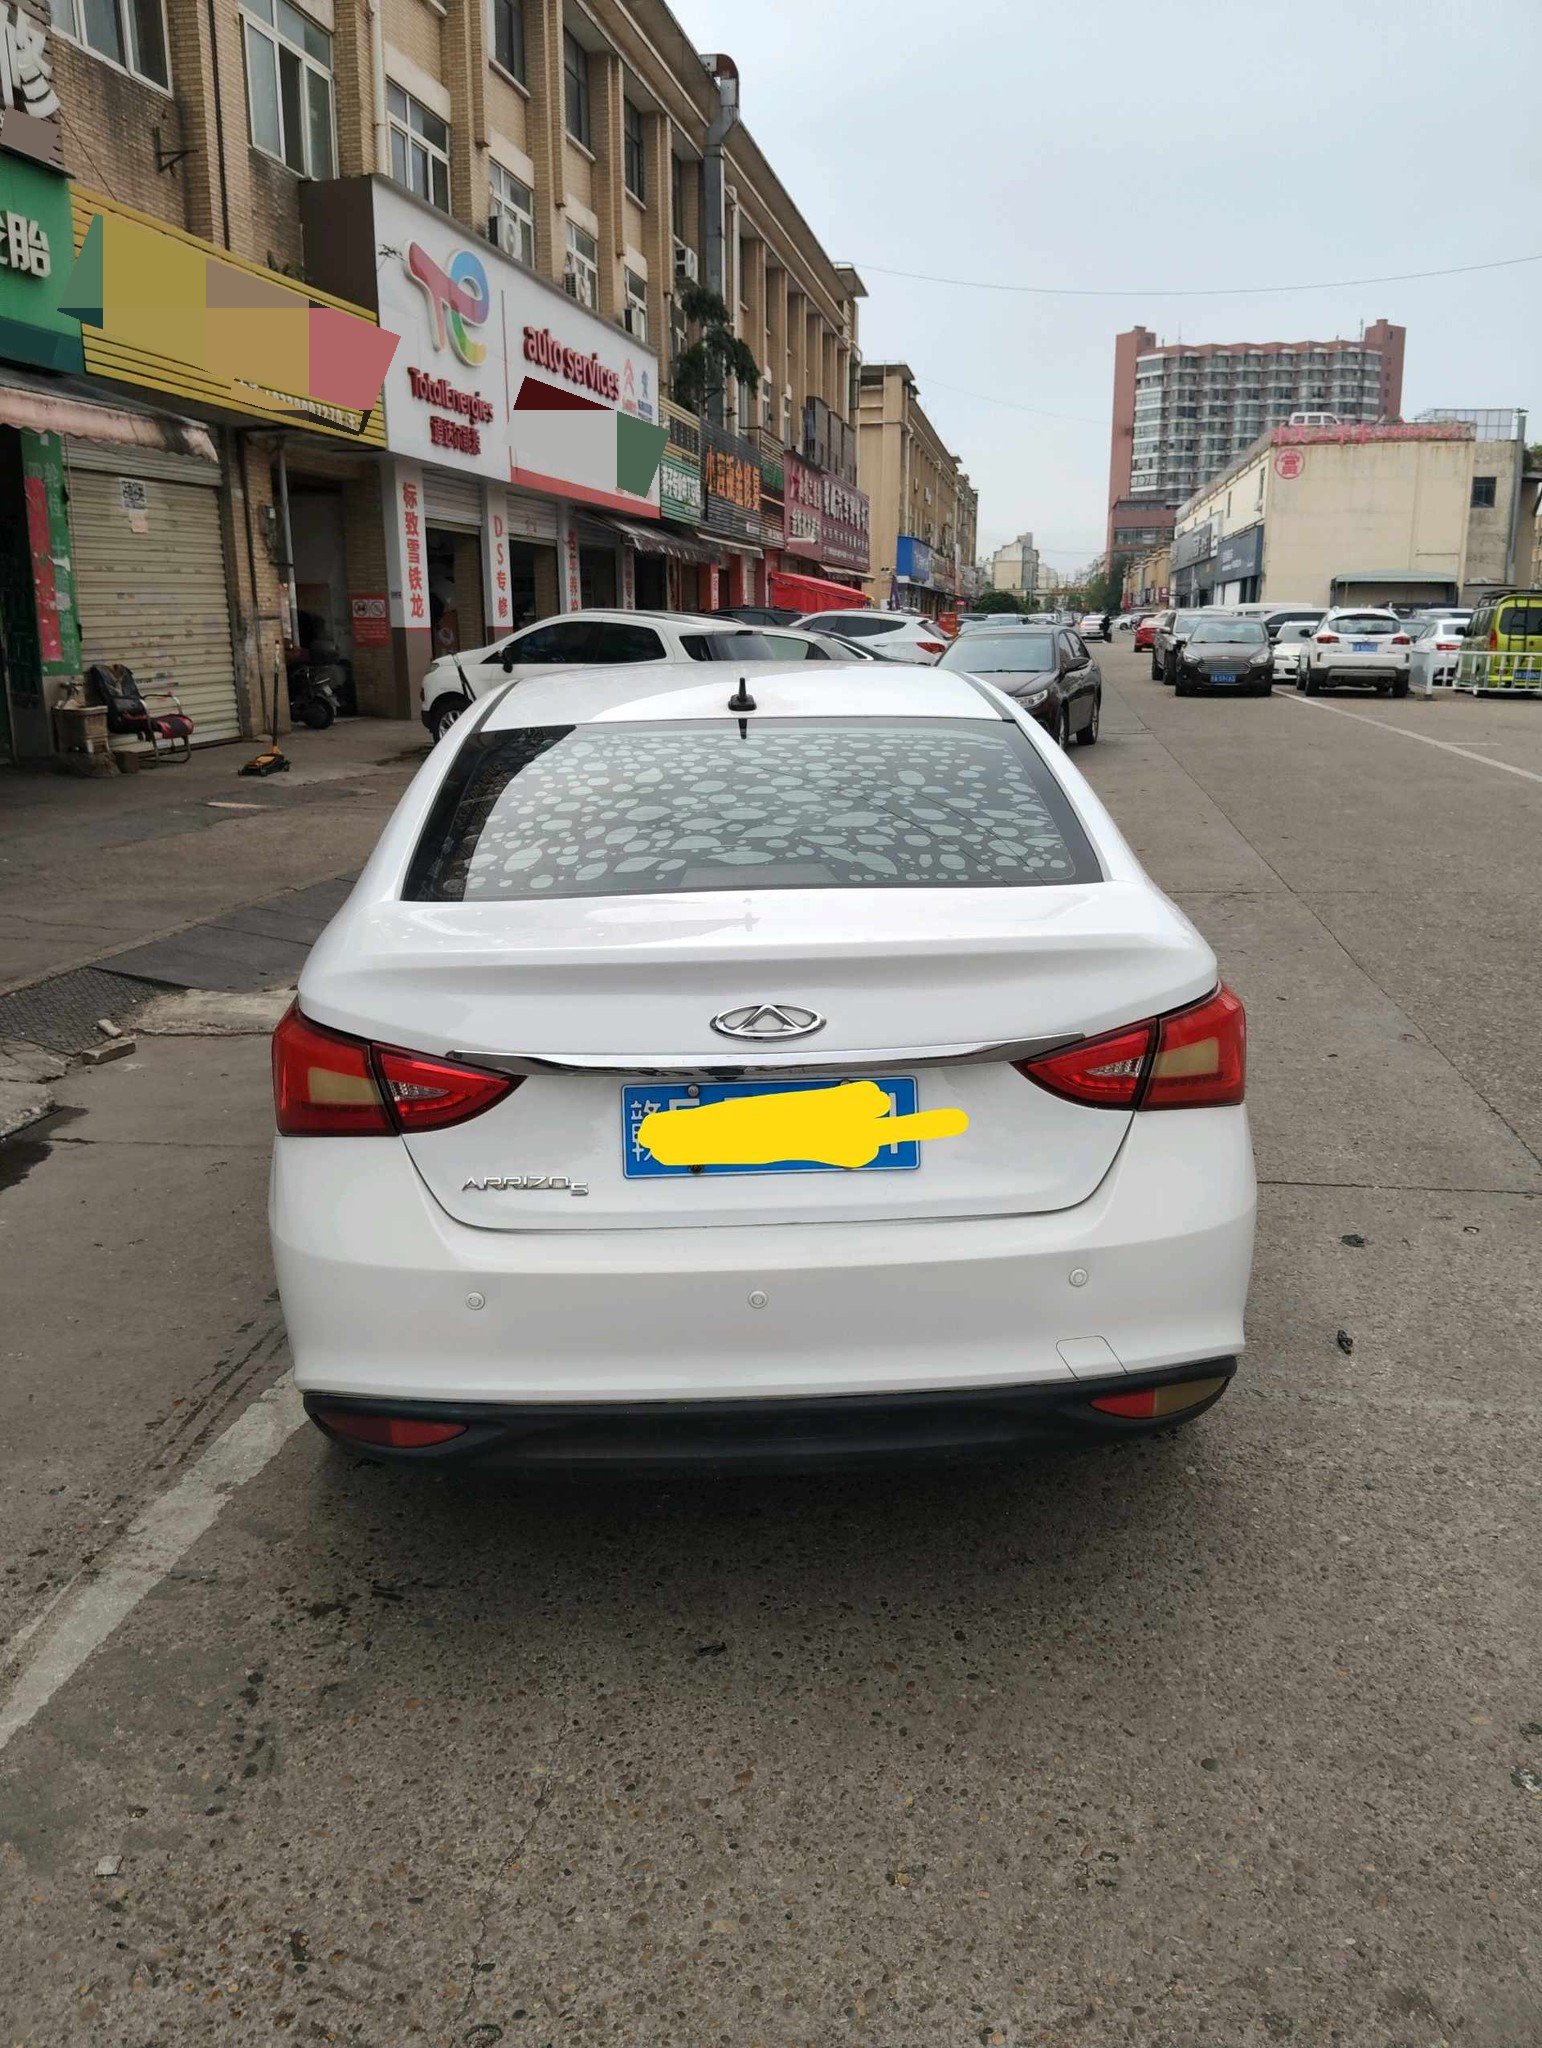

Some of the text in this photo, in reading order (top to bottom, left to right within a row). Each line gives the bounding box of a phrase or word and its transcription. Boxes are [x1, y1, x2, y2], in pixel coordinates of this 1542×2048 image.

[407, 366, 493, 424] TotalEnergies
[523, 325, 620, 401] auto services
[402, 481, 424, 619] 标致雪铁龙
